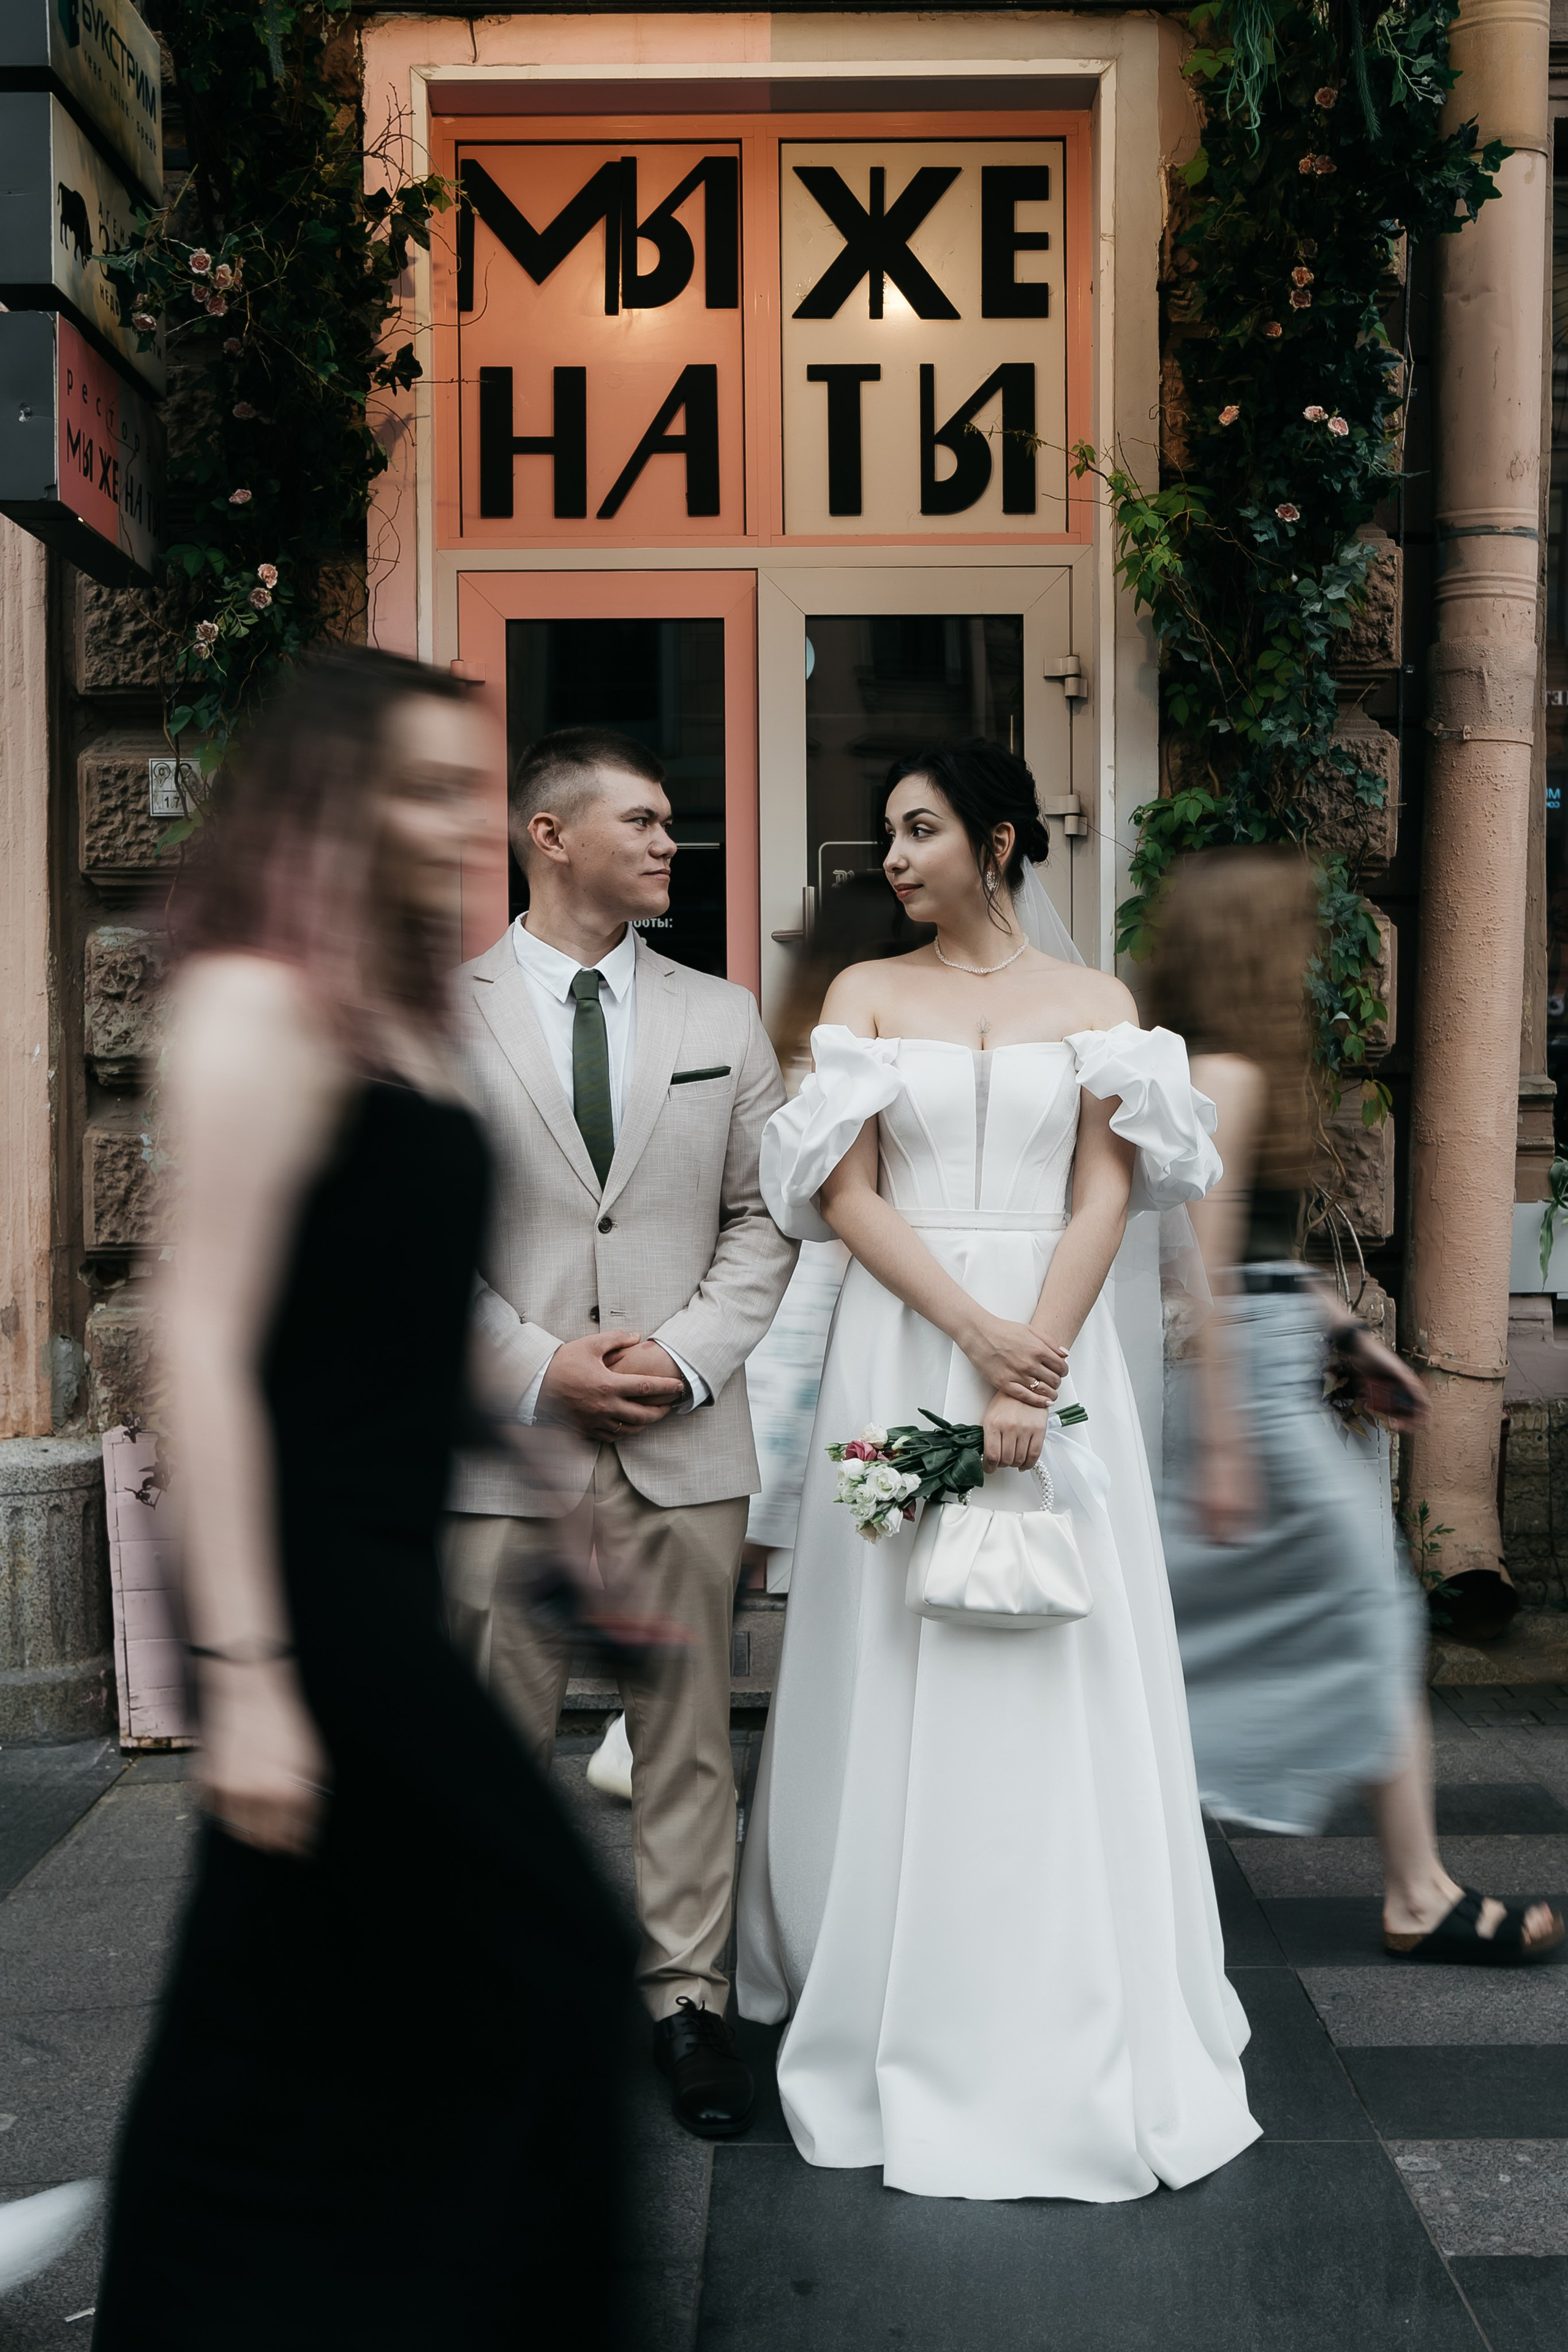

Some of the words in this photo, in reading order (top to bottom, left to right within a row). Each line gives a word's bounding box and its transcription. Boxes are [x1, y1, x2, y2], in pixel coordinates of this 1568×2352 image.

[83, 0, 156, 124] БУКСТРИМ
[85, 50, 102, 81] read
[110, 81, 129, 118] think
[137, 121, 157, 156] speak
[457, 156, 739, 316] МЫ
[791, 165, 1050, 320] ЖЕ
[67, 418, 93, 483] МЫ
[99, 446, 118, 504] ЖЕ
[125, 475, 142, 524] НА
[480, 364, 720, 519] НА
[806, 363, 1036, 516] ТЫ
